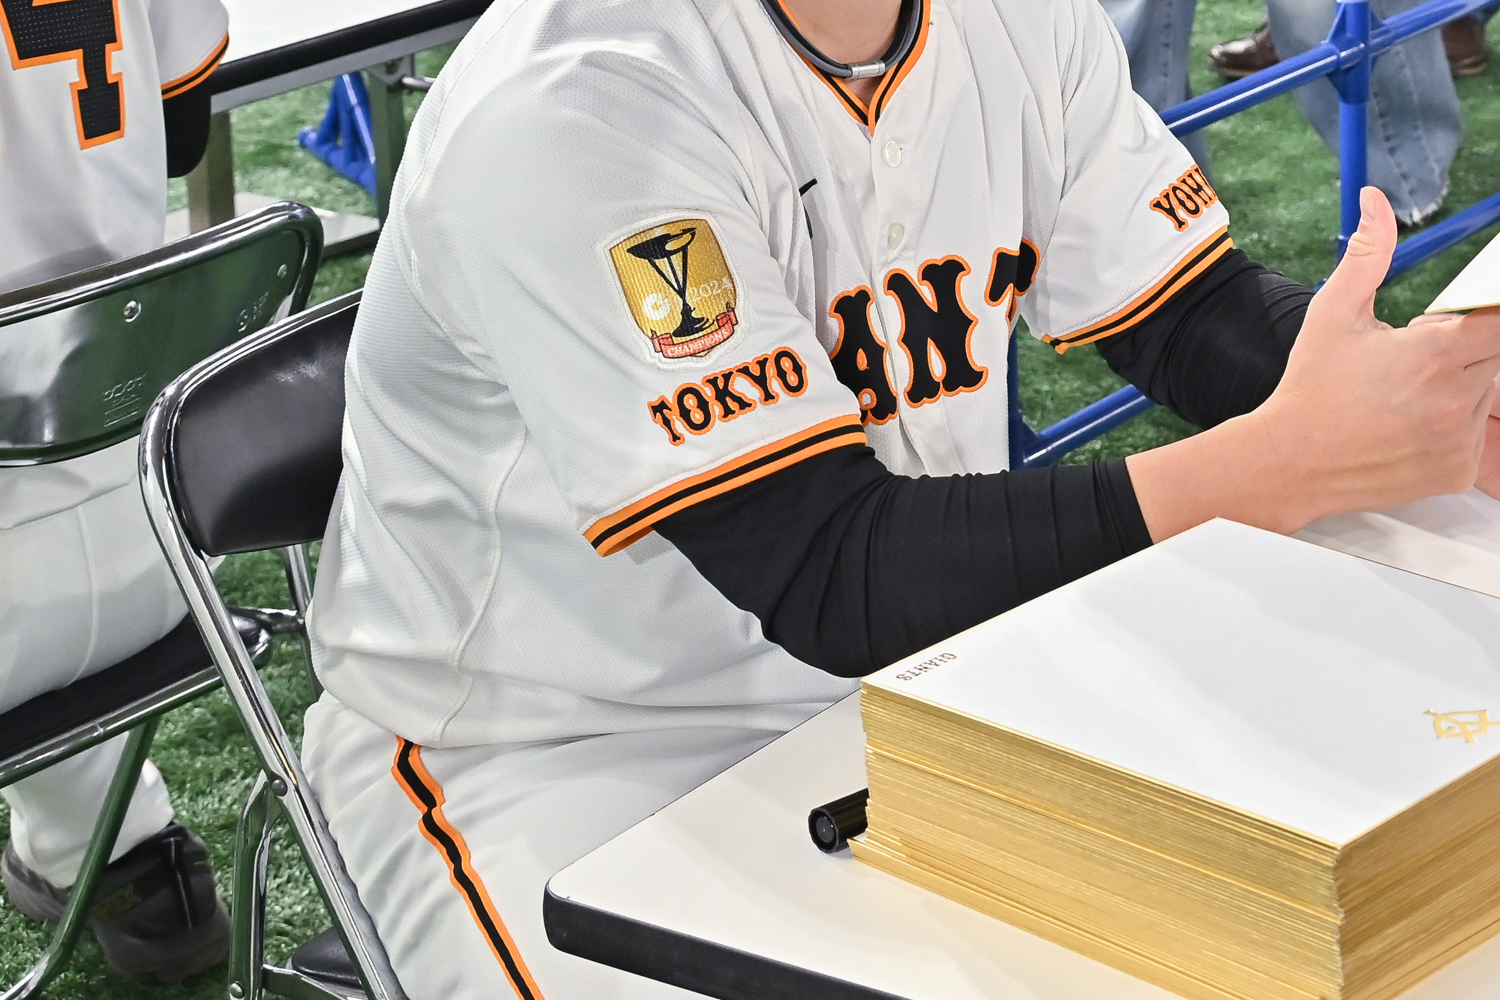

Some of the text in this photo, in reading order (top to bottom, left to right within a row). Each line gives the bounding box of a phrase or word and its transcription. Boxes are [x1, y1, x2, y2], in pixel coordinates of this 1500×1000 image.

[691, 274, 733, 302] 2024
[667, 328, 729, 357] CHAMPIONS
[647, 346, 809, 447] TOKYO
[896, 652, 957, 681] GIANTS
